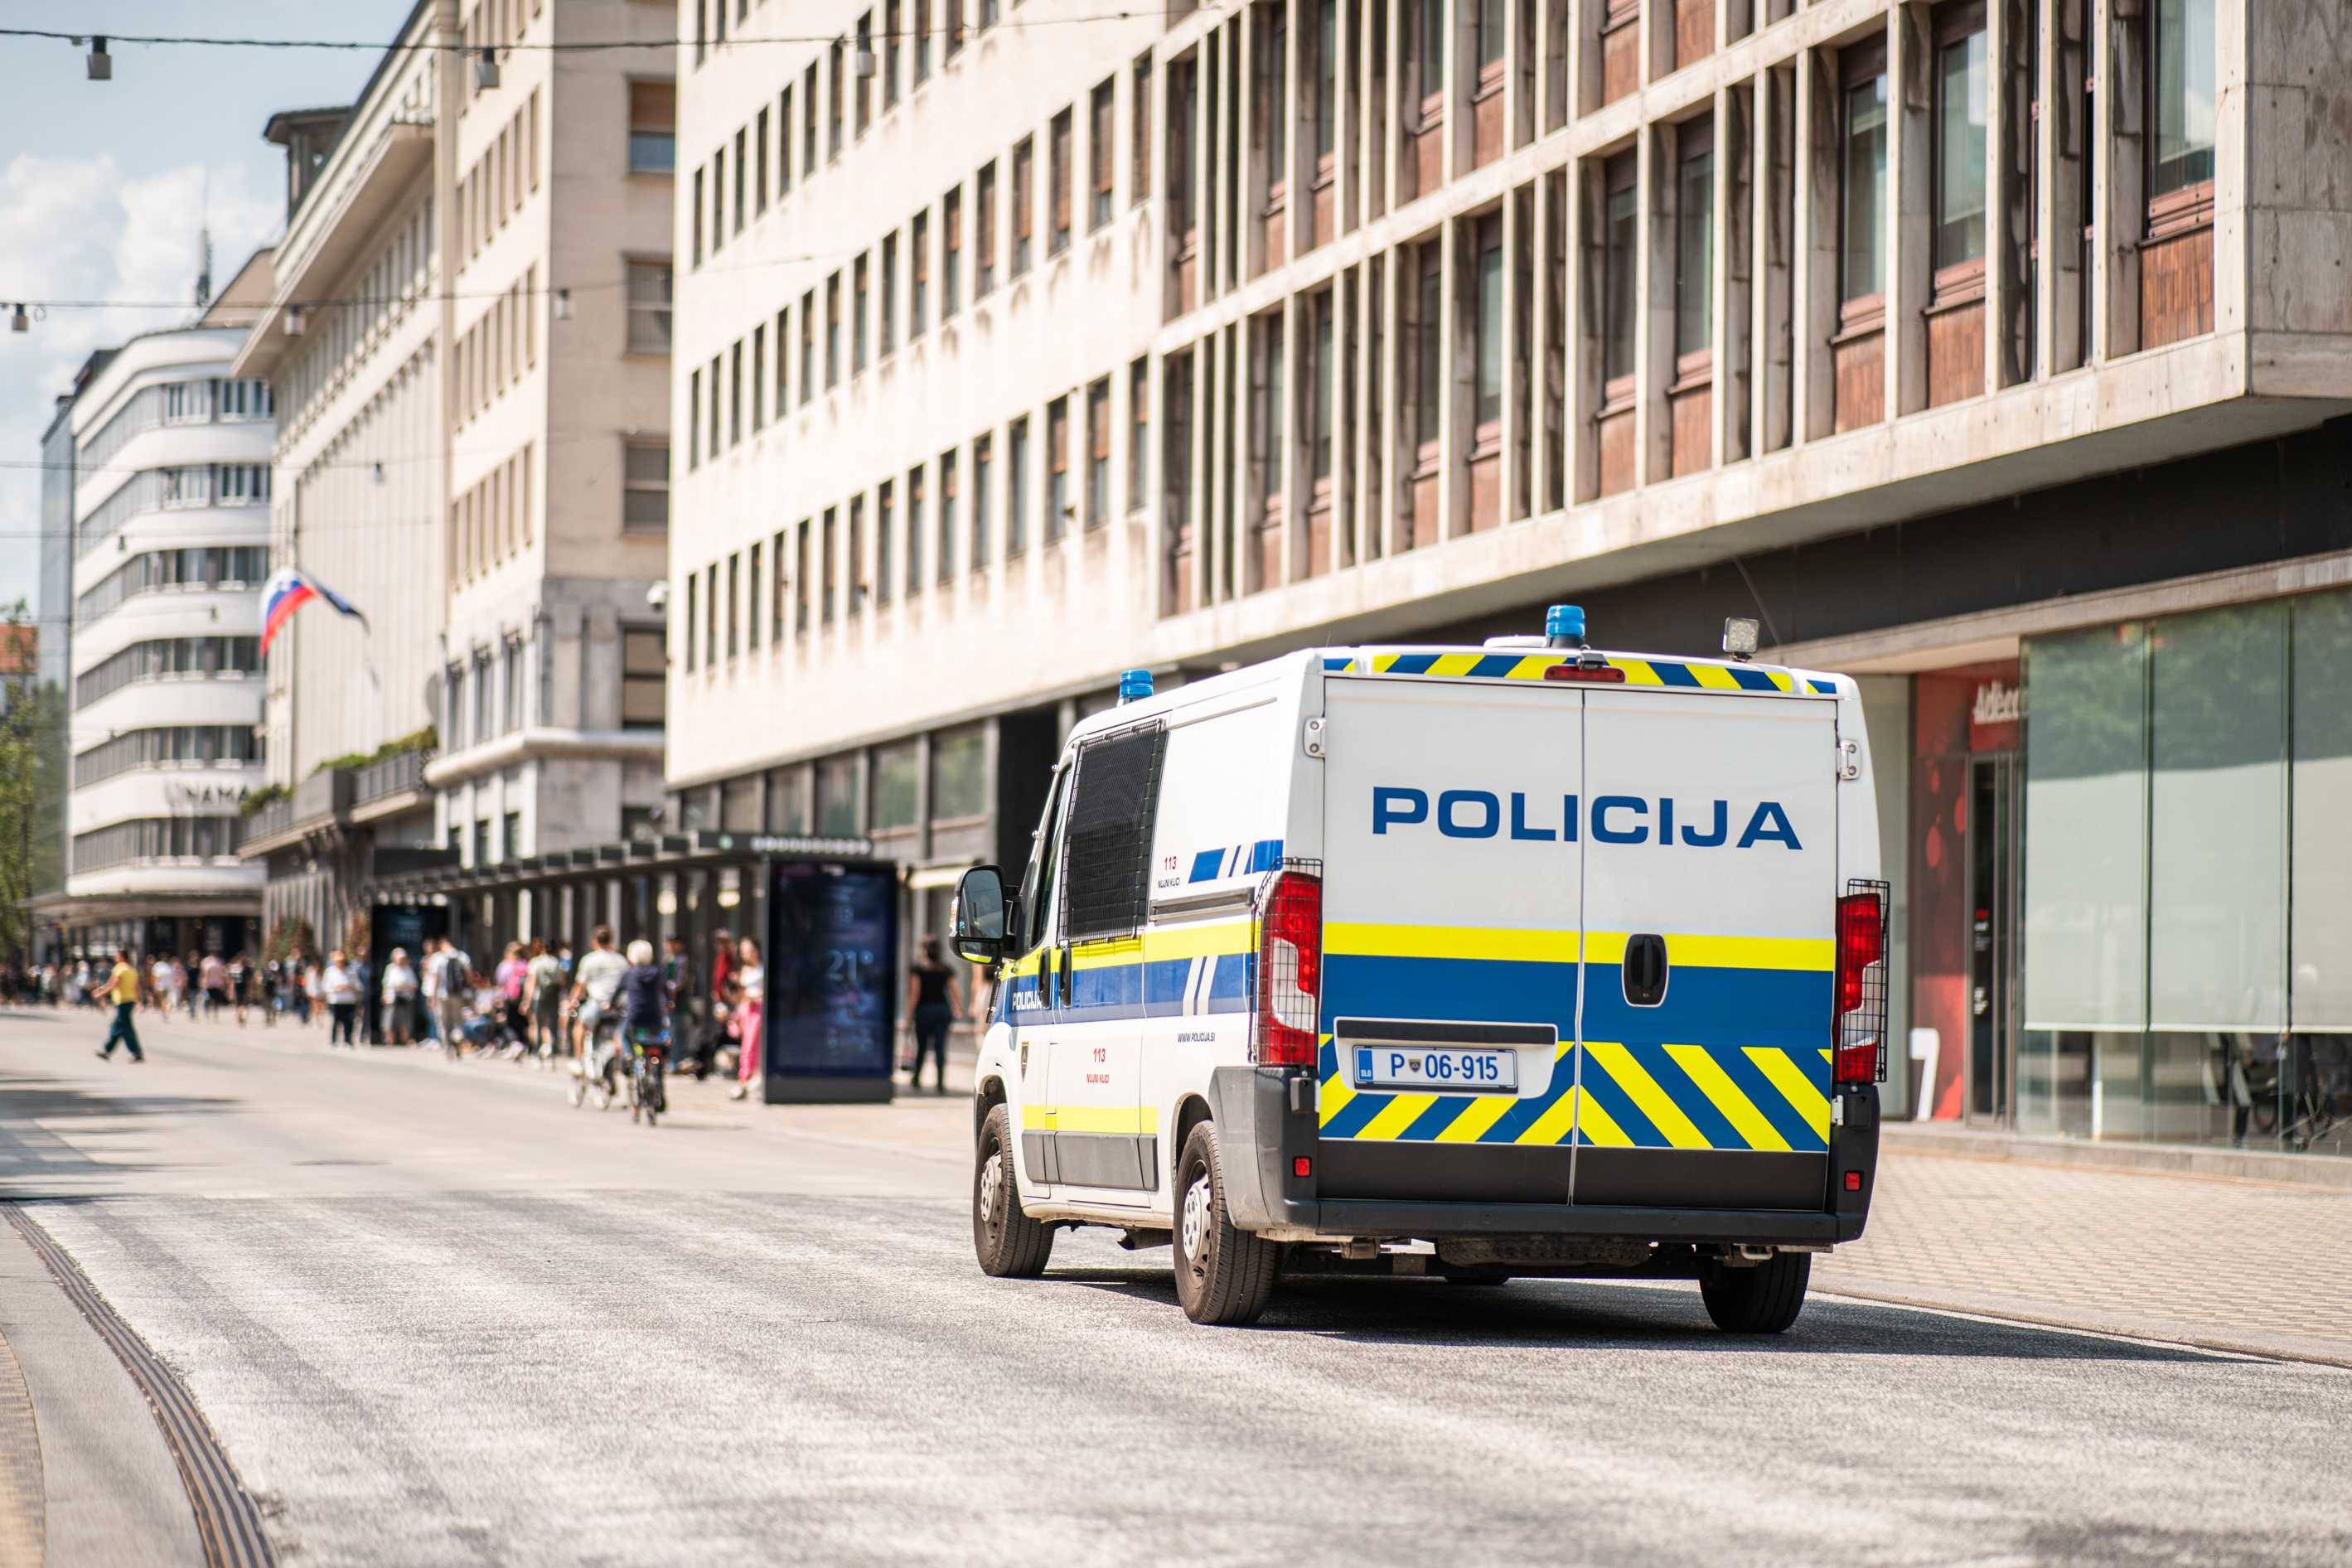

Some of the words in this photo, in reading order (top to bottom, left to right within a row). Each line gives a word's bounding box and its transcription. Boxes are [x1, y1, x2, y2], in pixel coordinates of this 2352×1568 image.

[1372, 786, 1803, 851] POLICIJA
[1164, 855, 1177, 871] 113
[1012, 990, 1043, 1011] POLICIJA
[1177, 1032, 1216, 1043] WWW.POLICIJA.SI
[1093, 1048, 1106, 1062] 113
[1360, 1069, 1372, 1077] SLO
[1390, 1053, 1406, 1077] P
[1425, 1053, 1498, 1081] 06-915
